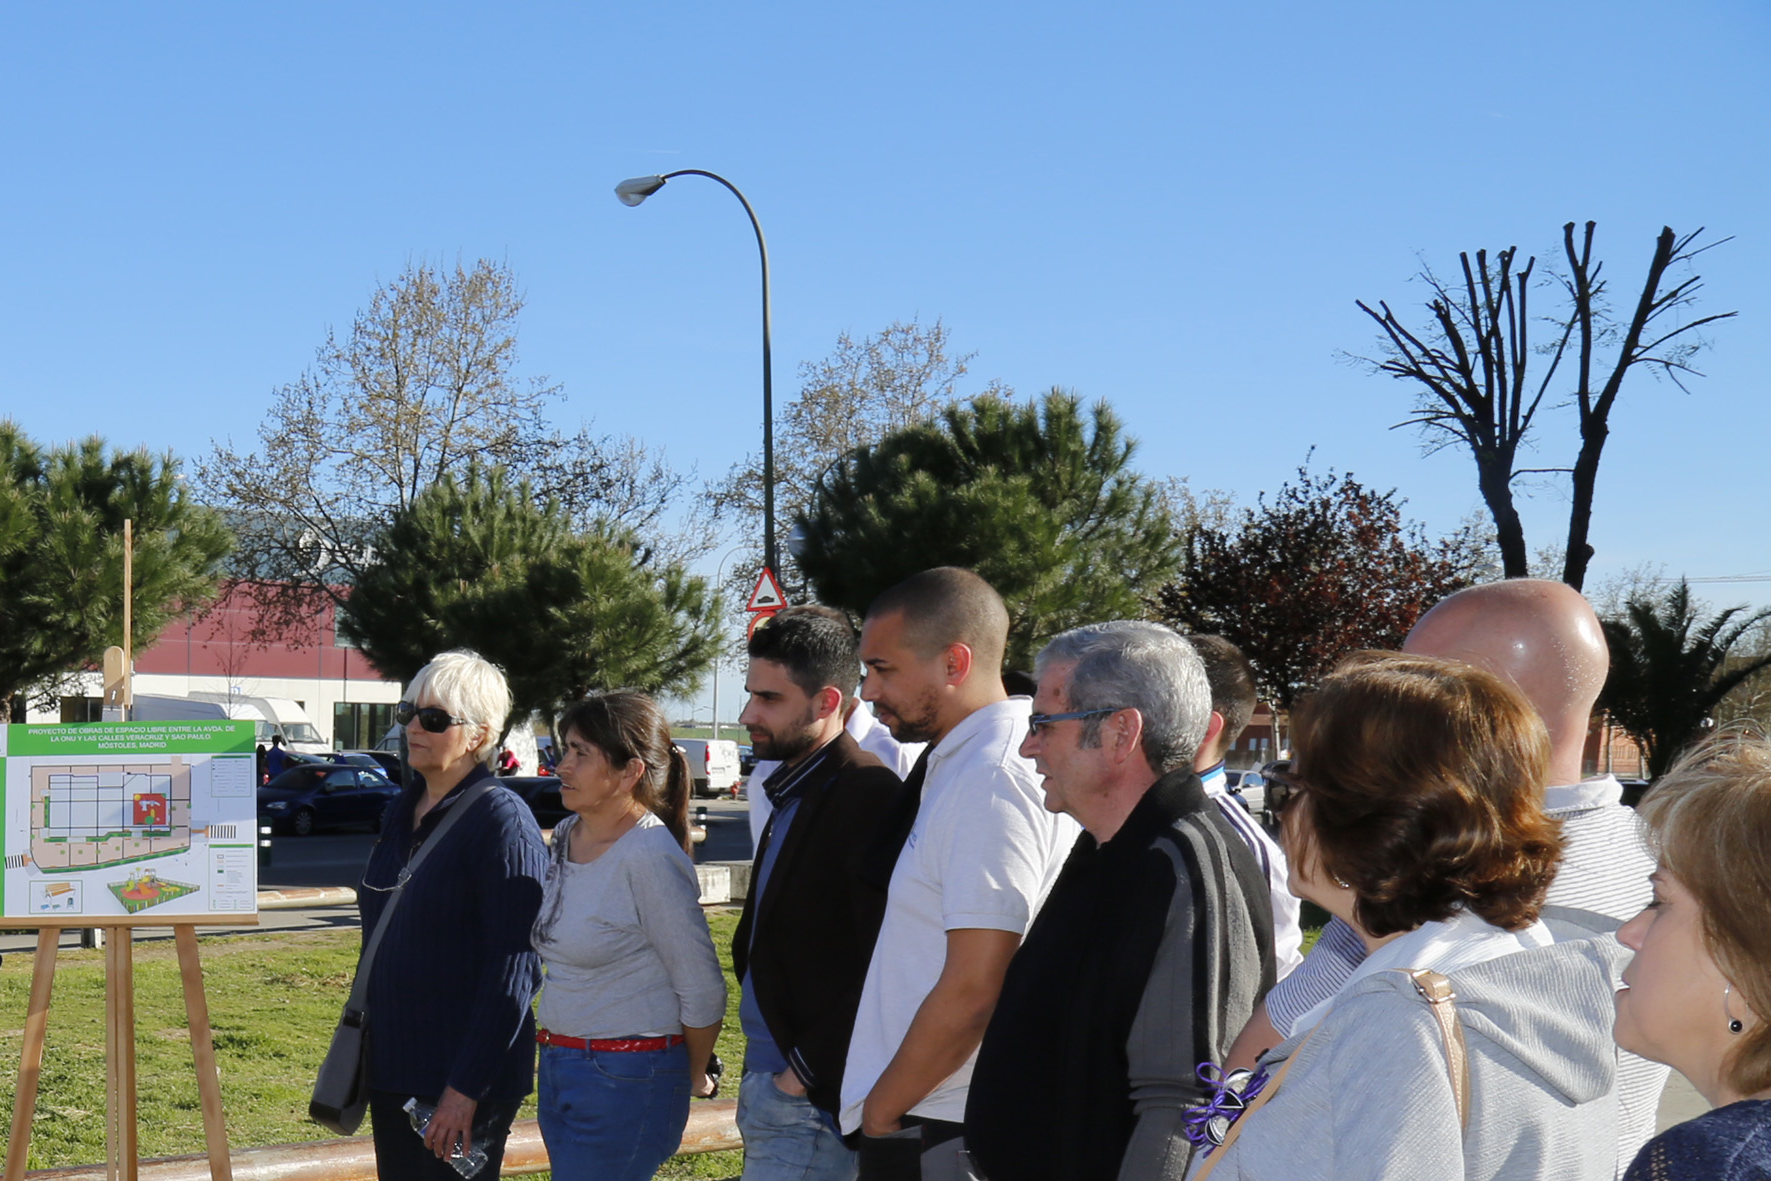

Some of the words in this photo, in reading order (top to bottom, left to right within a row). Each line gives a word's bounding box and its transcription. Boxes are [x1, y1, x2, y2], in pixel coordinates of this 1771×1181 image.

[28, 727, 67, 735] PROYECTO
[168, 725, 191, 733] ENTRE
[50, 735, 60, 743] LA
[126, 733, 164, 741] VERACRUZ
